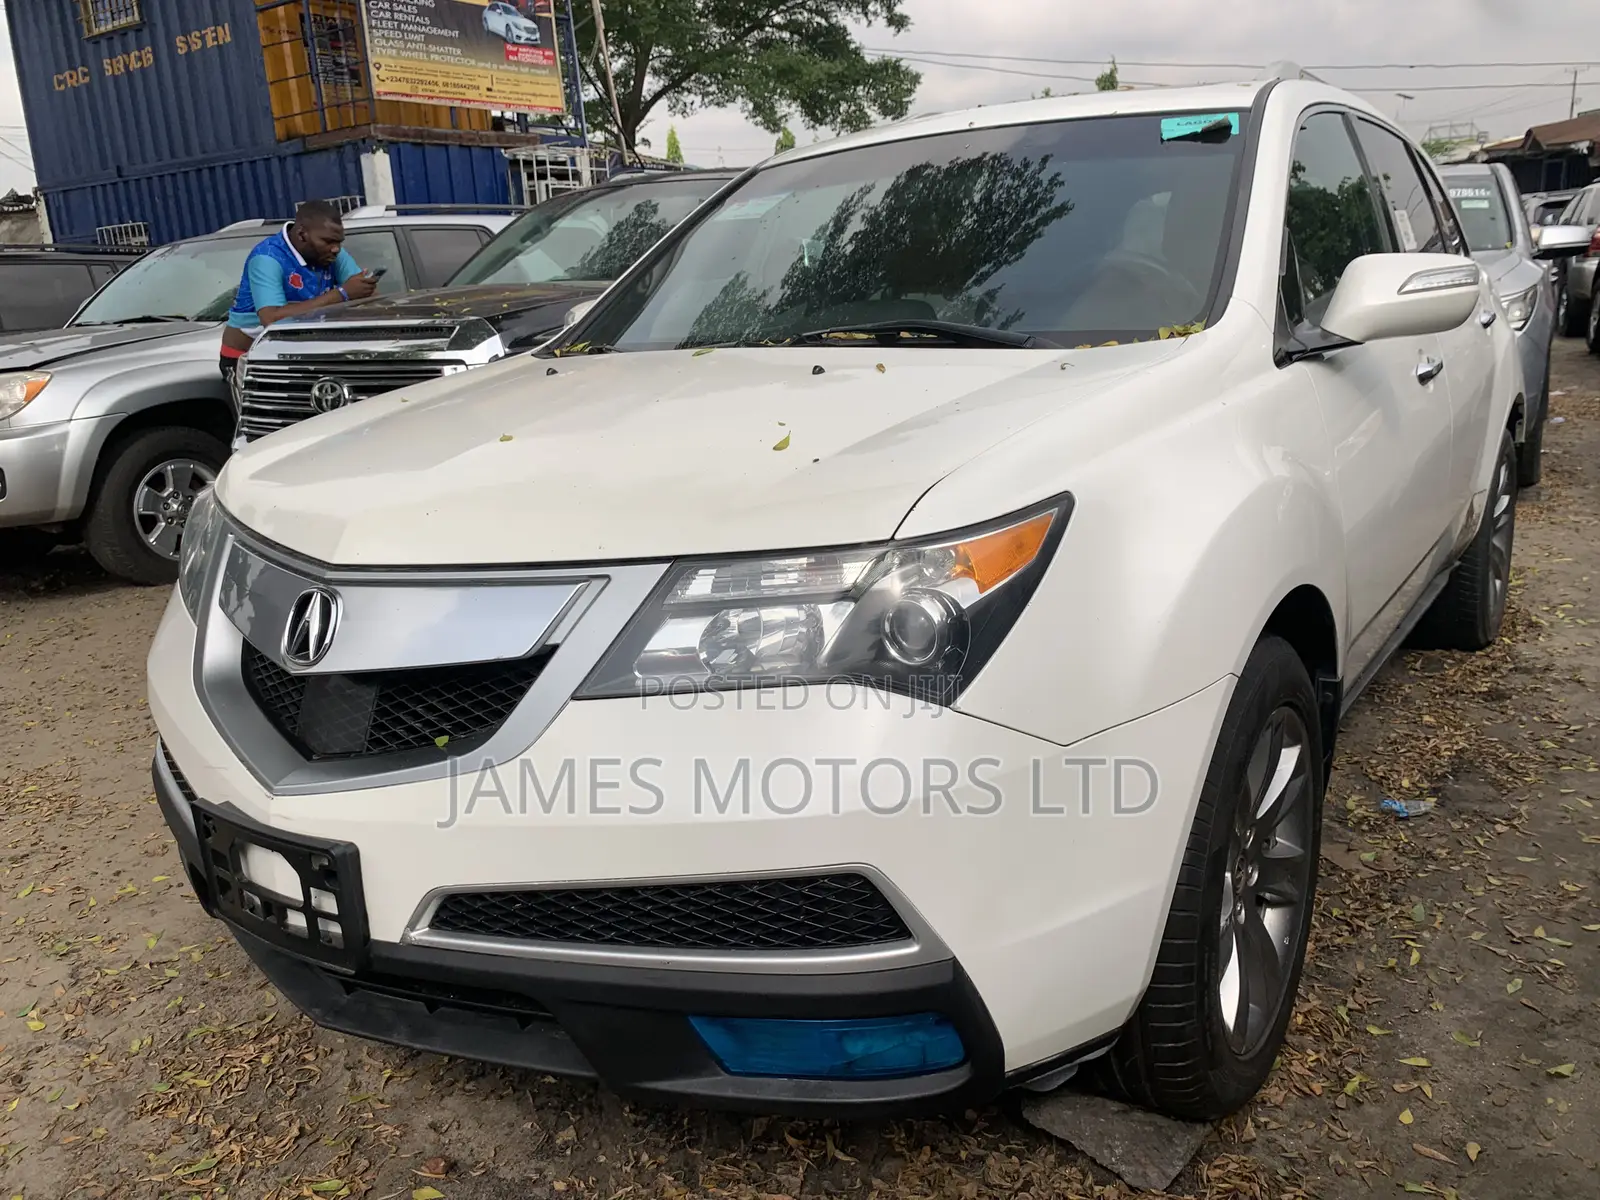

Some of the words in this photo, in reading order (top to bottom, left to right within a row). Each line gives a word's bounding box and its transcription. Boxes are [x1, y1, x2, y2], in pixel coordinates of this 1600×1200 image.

[369, 1, 391, 10] CAR
[393, 3, 418, 14] SALES
[371, 10, 392, 19] CAR
[394, 12, 430, 25] RENTALS
[372, 20, 399, 29] FLEET
[401, 23, 459, 38] MANAGEMENT
[372, 29, 402, 39] SPEED
[404, 32, 425, 42] LIMIT
[374, 38, 405, 48] GLASS
[407, 42, 462, 56] ANTI-SHATTER
[375, 47, 399, 57] TYRE
[401, 50, 428, 60] WHEEL
[431, 53, 476, 66] PROTECTOR
